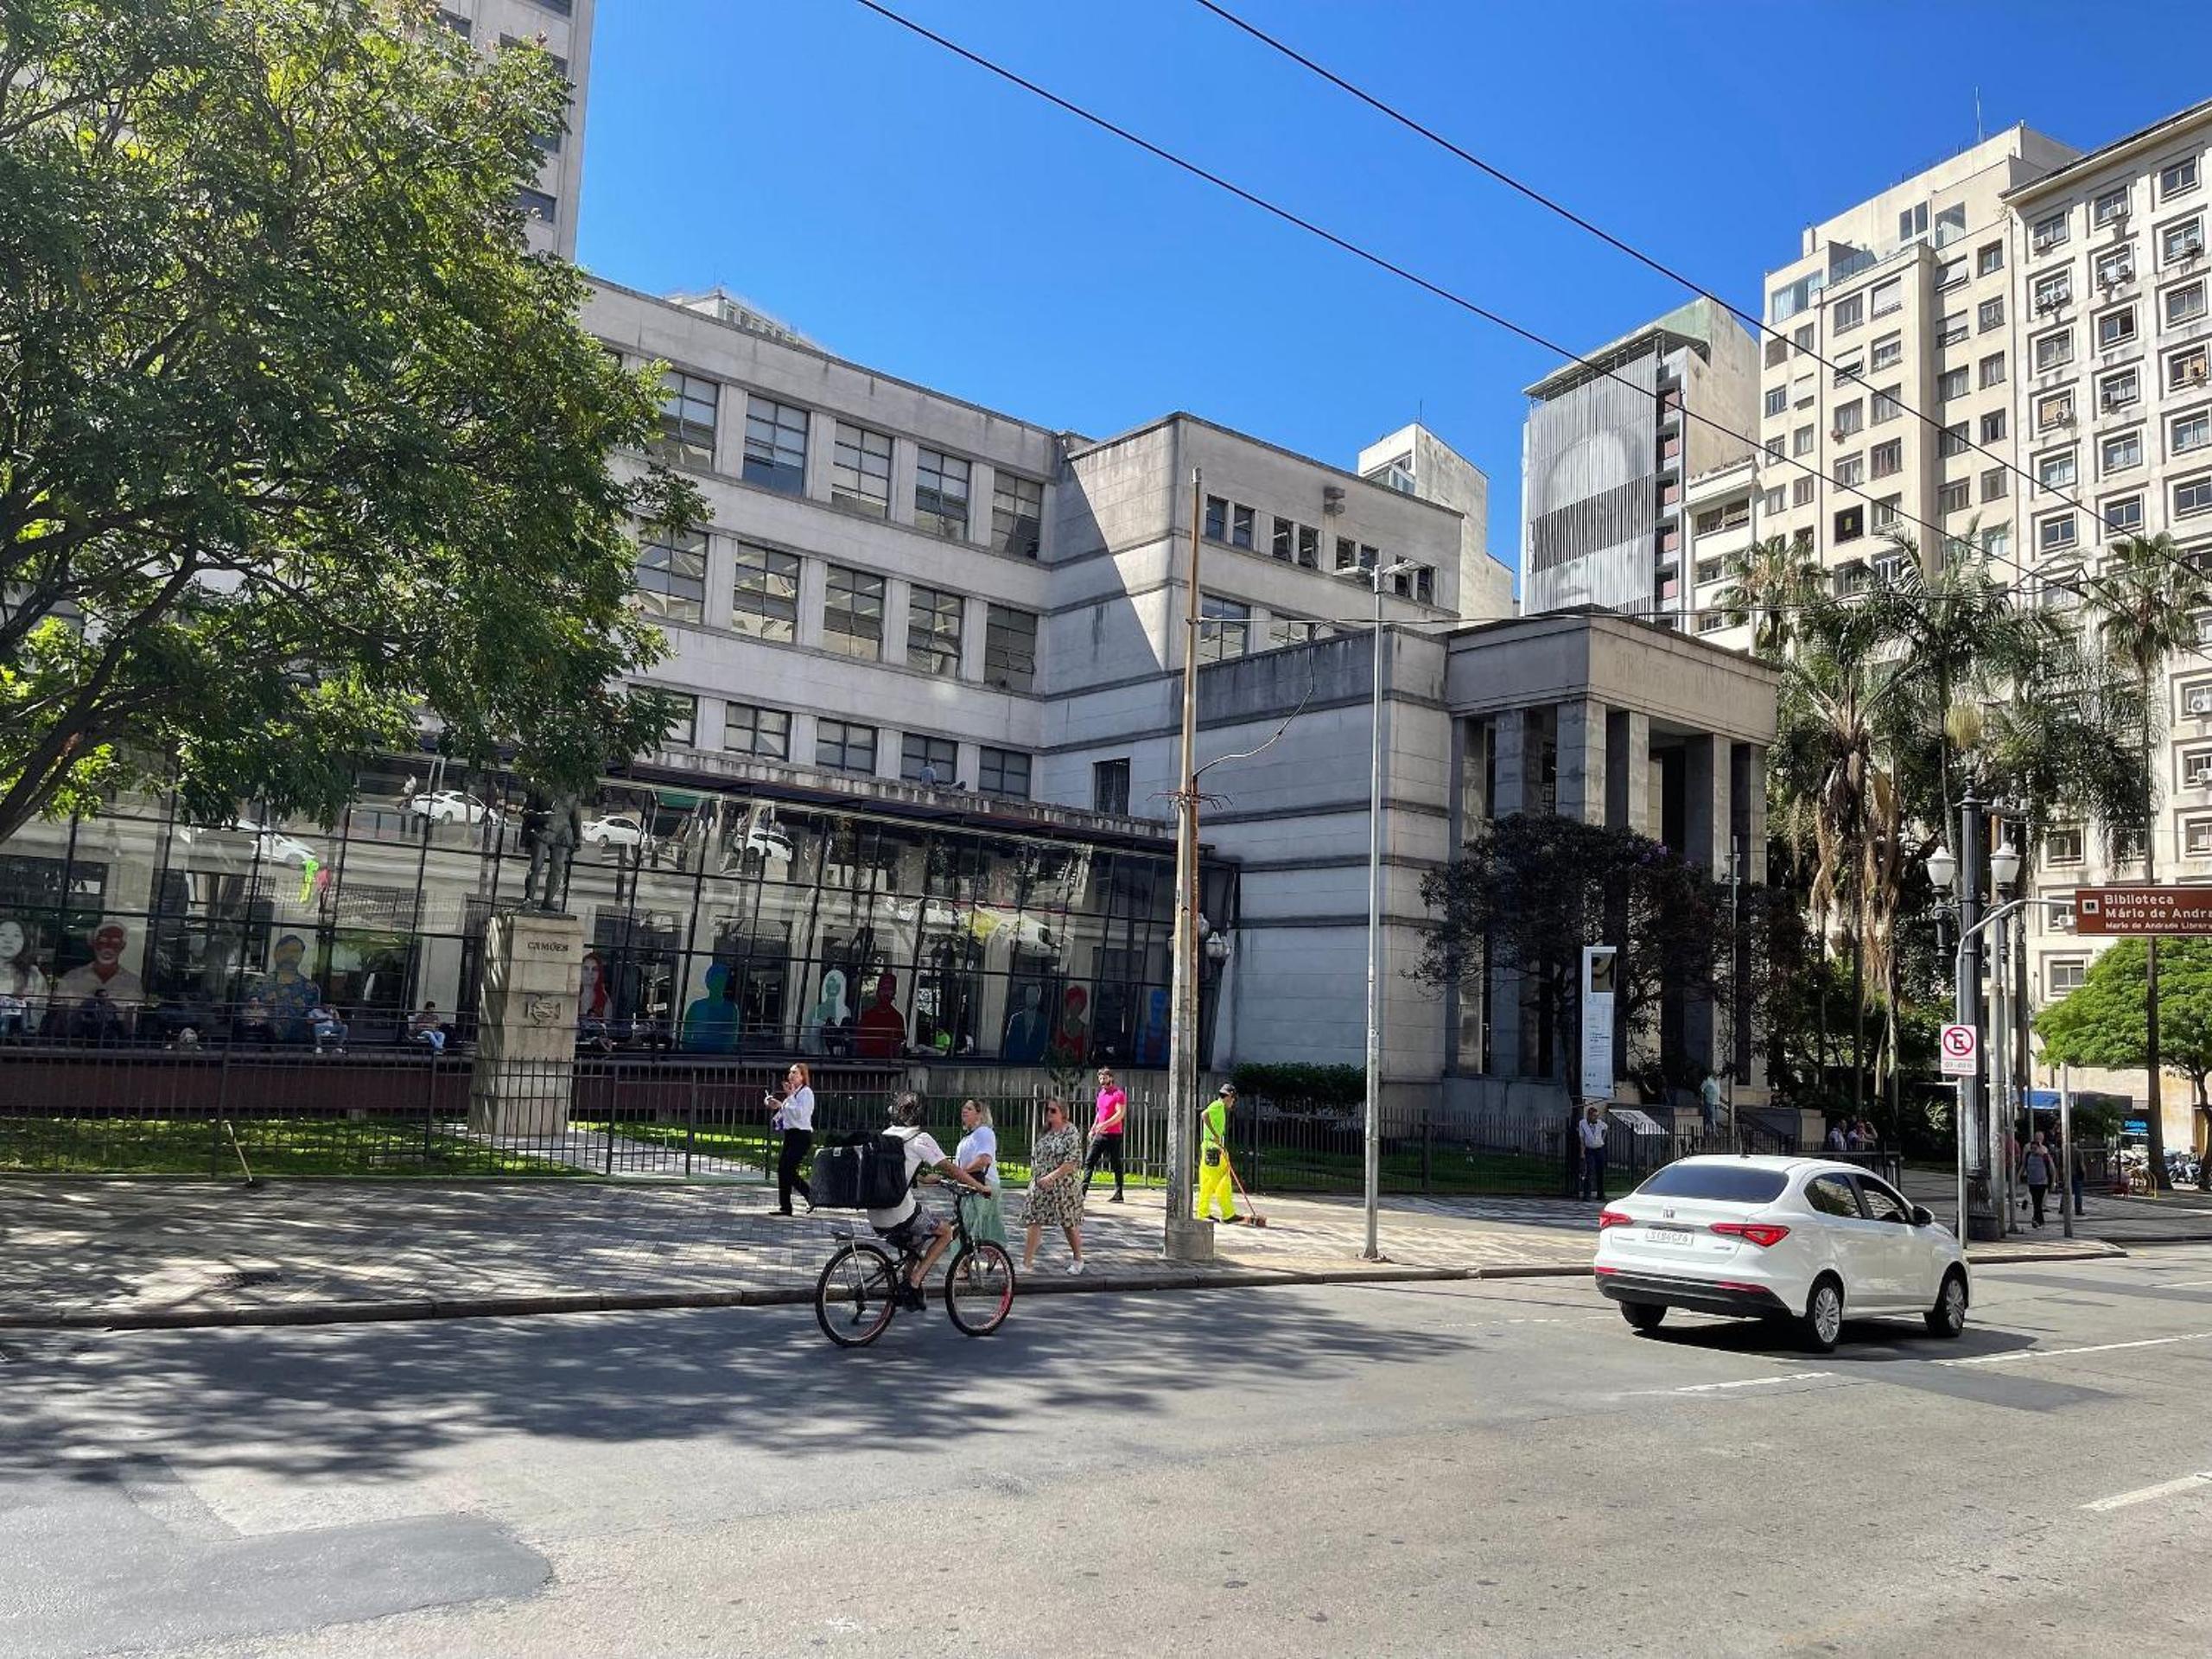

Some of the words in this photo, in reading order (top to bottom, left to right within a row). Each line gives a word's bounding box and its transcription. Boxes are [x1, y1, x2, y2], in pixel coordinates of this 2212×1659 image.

[2104, 894, 2175, 905] Biblioteca
[2105, 907, 2145, 918] Mário
[2150, 908, 2166, 918] de
[1954, 1033, 1965, 1050] E
